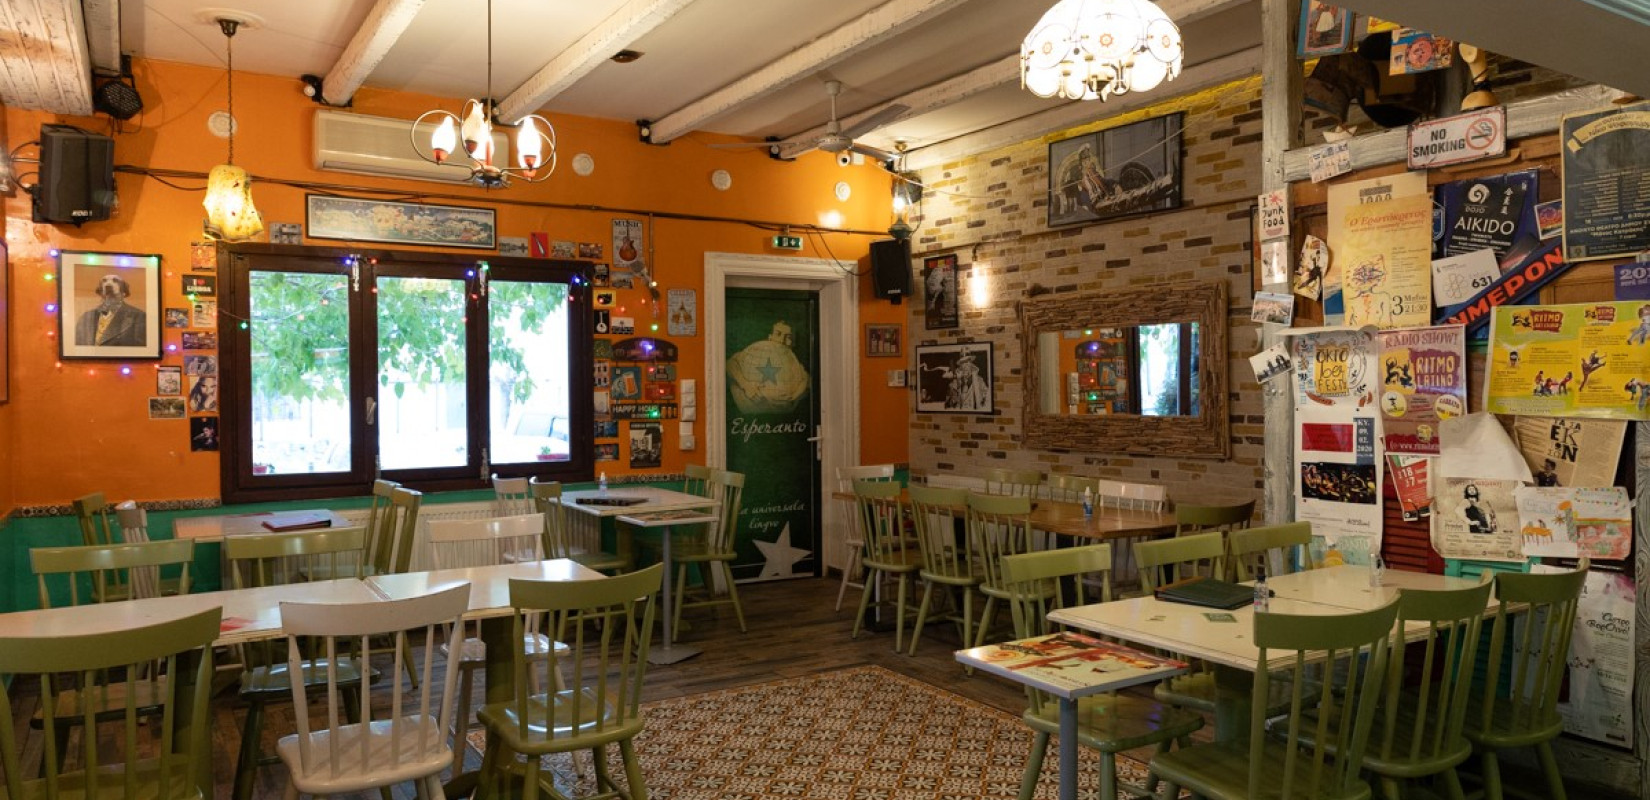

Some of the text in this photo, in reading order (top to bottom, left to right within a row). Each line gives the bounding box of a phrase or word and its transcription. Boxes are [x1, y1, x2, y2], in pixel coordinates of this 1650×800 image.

[1430, 129, 1447, 142] NO
[1413, 138, 1466, 158] SMOKING
[1262, 198, 1267, 208] I
[1263, 218, 1285, 228] Food
[1454, 215, 1515, 235] AIKIDO
[1472, 275, 1493, 288] 631
[1392, 295, 1403, 316] 3
[1405, 304, 1427, 313] 21:30
[1534, 314, 1560, 323] RITMO
[1385, 333, 1419, 348] RADIO
[1416, 355, 1455, 374] RITMO
[1416, 374, 1453, 387] LATINO
[612, 404, 636, 412] HAPPY
[731, 417, 806, 443] Esperanto
[1401, 467, 1413, 478] 18
